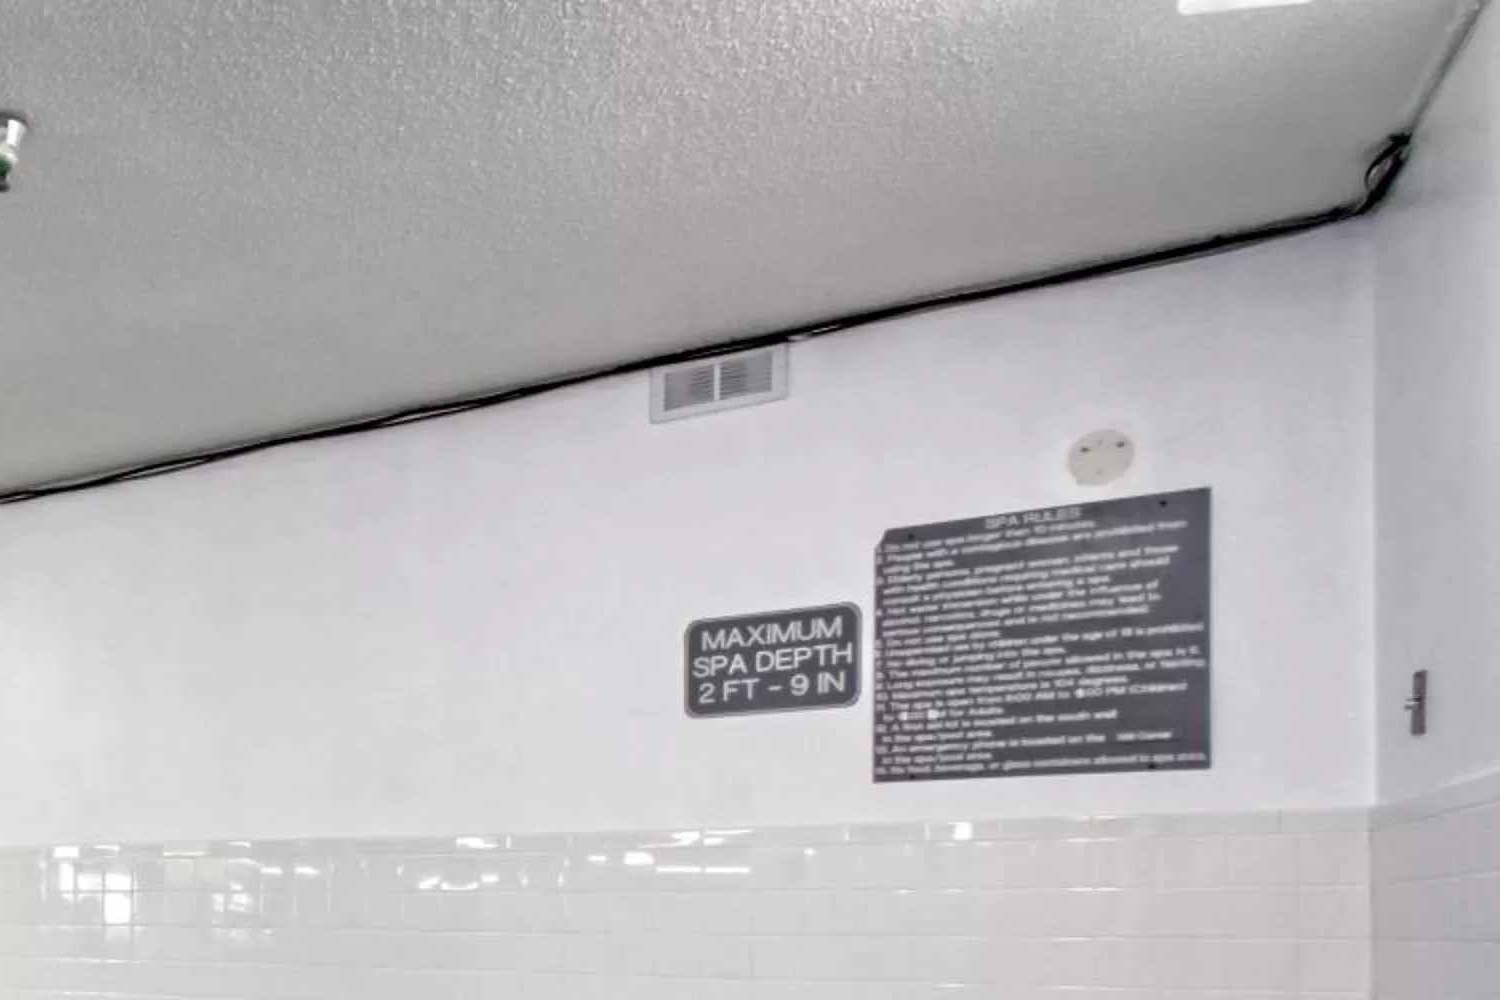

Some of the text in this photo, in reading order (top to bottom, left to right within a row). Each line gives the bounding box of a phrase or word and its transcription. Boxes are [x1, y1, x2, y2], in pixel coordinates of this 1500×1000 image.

[701, 616, 843, 651] MAXIMUM
[692, 642, 853, 678] SPA DEPTH
[699, 682, 717, 704] 2
[723, 677, 761, 702] FT
[790, 674, 810, 696] 9
[816, 670, 846, 695] IN
